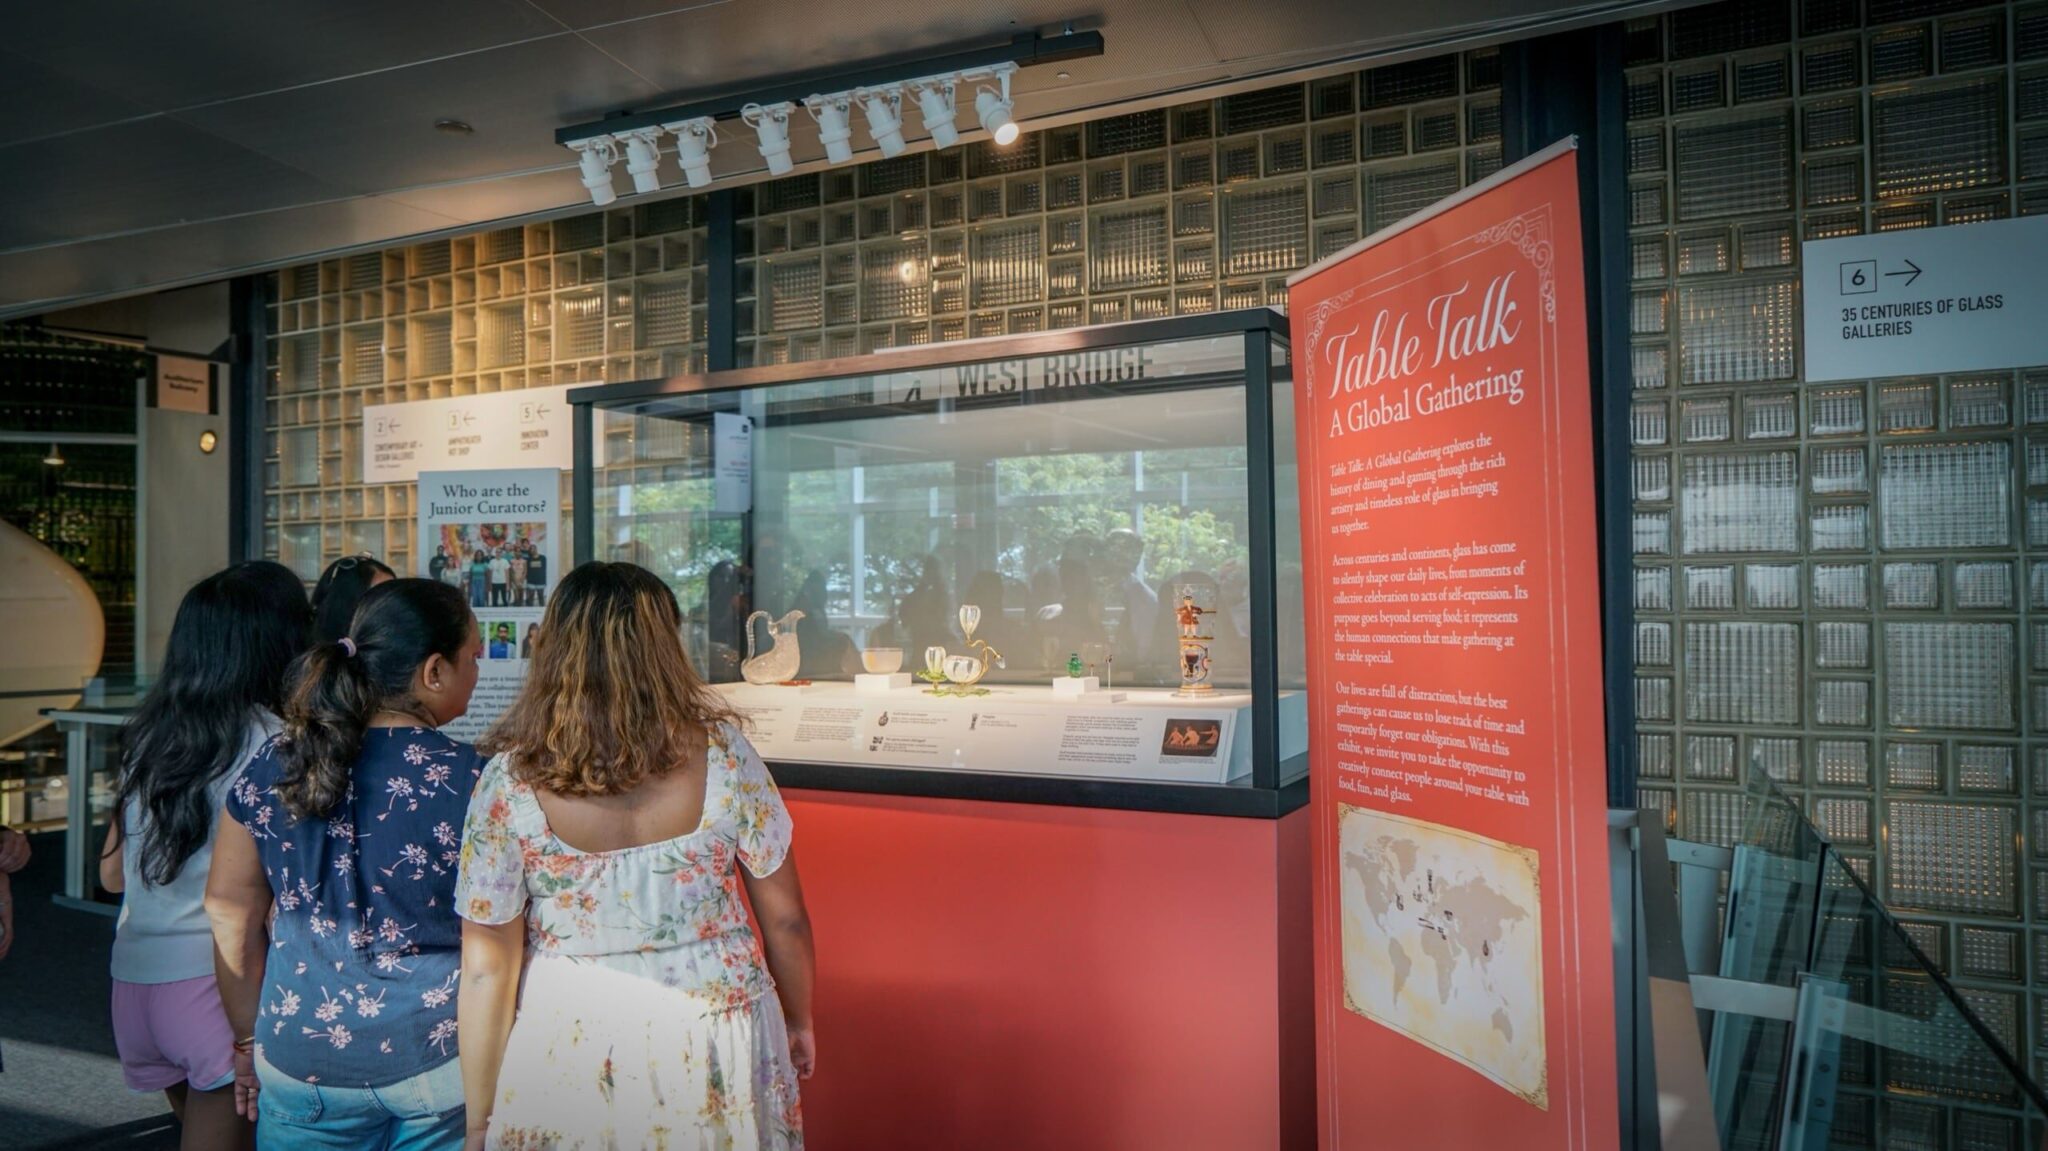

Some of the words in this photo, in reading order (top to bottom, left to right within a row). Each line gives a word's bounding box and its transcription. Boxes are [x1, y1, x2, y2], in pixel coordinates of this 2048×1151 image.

[1852, 268, 1865, 286] 6
[1842, 307, 1857, 322] 35
[1861, 300, 1932, 320] CENTURIES
[1937, 298, 1954, 314] OF
[1958, 294, 2004, 312] GLASS
[1326, 310, 1424, 400] Table
[1428, 270, 1522, 368] Talk
[1842, 320, 1912, 340] GALLERIES
[956, 358, 1029, 397] WEST
[1043, 346, 1154, 390] BRIDGE
[1330, 409, 1344, 438] A
[1348, 388, 1411, 432] Global
[1416, 366, 1524, 405] Gathering
[1330, 462, 1347, 477] Table
[1366, 456, 1373, 470] A
[1375, 450, 1401, 468] Global
[1402, 445, 1441, 463] Gathering
[1442, 438, 1474, 458] explores
[1476, 432, 1492, 448] the
[1330, 483, 1352, 497] history
[1353, 478, 1362, 492] of
[1363, 477, 1388, 491] dining
[1389, 471, 1405, 486] and
[1406, 468, 1436, 487] gaming
[1437, 459, 1468, 478] through
[1470, 457, 1484, 472] the
[1486, 452, 1506, 469] rich
[443, 484, 478, 498] Who
[481, 488, 504, 498] are
[506, 483, 530, 496] the
[1355, 498, 1369, 511] and
[1370, 494, 1403, 509] timeless
[1404, 490, 1420, 504] role
[1422, 488, 1432, 502] of
[1432, 486, 1450, 504] glass
[1451, 485, 1459, 498] in
[1460, 480, 1498, 498] bringing
[428, 502, 474, 519] Junior
[478, 500, 547, 514] Curators?
[1331, 526, 1339, 534] us
[1339, 519, 1369, 536] together.
[1332, 554, 1354, 566] Across
[1355, 552, 1389, 564] centuries
[1391, 548, 1407, 562] and
[1452, 543, 1471, 562] glass
[1472, 541, 1488, 556] has
[1490, 543, 1516, 554] come
[1333, 575, 1340, 585] to
[1341, 572, 1364, 587] silently
[1366, 571, 1388, 586] shape
[1390, 573, 1405, 582] our
[1407, 568, 1427, 584] daily
[1428, 567, 1448, 581] lives,
[1449, 565, 1467, 579] from
[1469, 564, 1511, 578] moments
[1514, 560, 1526, 576] of
[1333, 592, 1363, 604] collective
[1364, 590, 1409, 603] celebration
[1410, 591, 1420, 602] to
[1421, 590, 1437, 602] acts
[1438, 588, 1448, 601] of
[1514, 585, 1528, 599] Its
[1334, 615, 1360, 627] purpose
[1361, 615, 1378, 627] goes
[1379, 610, 1410, 627] beyond
[1412, 612, 1442, 627] serving
[1463, 611, 1470, 623] it
[1471, 611, 1518, 627] represents
[1335, 630, 1345, 641] the
[1346, 630, 1370, 642] human
[1372, 632, 1421, 644] connections
[1423, 631, 1440, 644] that
[1441, 632, 1462, 645] make
[1463, 632, 1503, 650] gathering
[1504, 634, 1515, 646] at
[1335, 649, 1345, 661] the
[1346, 649, 1363, 662] table
[1336, 681, 1350, 694] Our
[1350, 682, 1367, 696] lives
[1368, 688, 1380, 697] are
[1382, 685, 1396, 699] full
[1397, 687, 1409, 700] of
[1458, 691, 1472, 706] but
[1474, 693, 1488, 707] the
[1488, 693, 1508, 709] best
[1336, 703, 1372, 720] gatherings
[1373, 710, 1387, 718] can
[1388, 711, 1412, 721] cause
[1413, 714, 1423, 722] us
[1424, 712, 1434, 724] to
[1435, 712, 1452, 726] lose
[1452, 715, 1472, 728] track
[1474, 716, 1484, 730] of
[1484, 718, 1504, 732] time
[1505, 720, 1525, 734] and
[1337, 722, 1378, 740] temporarily
[1379, 726, 1403, 743] forget
[1405, 733, 1420, 743] our
[1469, 737, 1490, 752] With
[1492, 741, 1510, 755] this
[1363, 748, 1375, 756] we
[1376, 747, 1399, 760] invite
[1400, 753, 1417, 765] you
[1418, 753, 1427, 765] to
[1428, 755, 1447, 768] take
[1448, 757, 1462, 771] the
[1462, 763, 1513, 783] opportunity
[1514, 768, 1525, 781] to
[1338, 762, 1370, 778] creatively
[1371, 768, 1403, 781] connect
[1404, 773, 1432, 789] people
[1433, 779, 1463, 793] around
[1465, 785, 1482, 798] your
[1484, 785, 1505, 801] table
[1506, 790, 1529, 805] with
[1373, 784, 1389, 796] and
